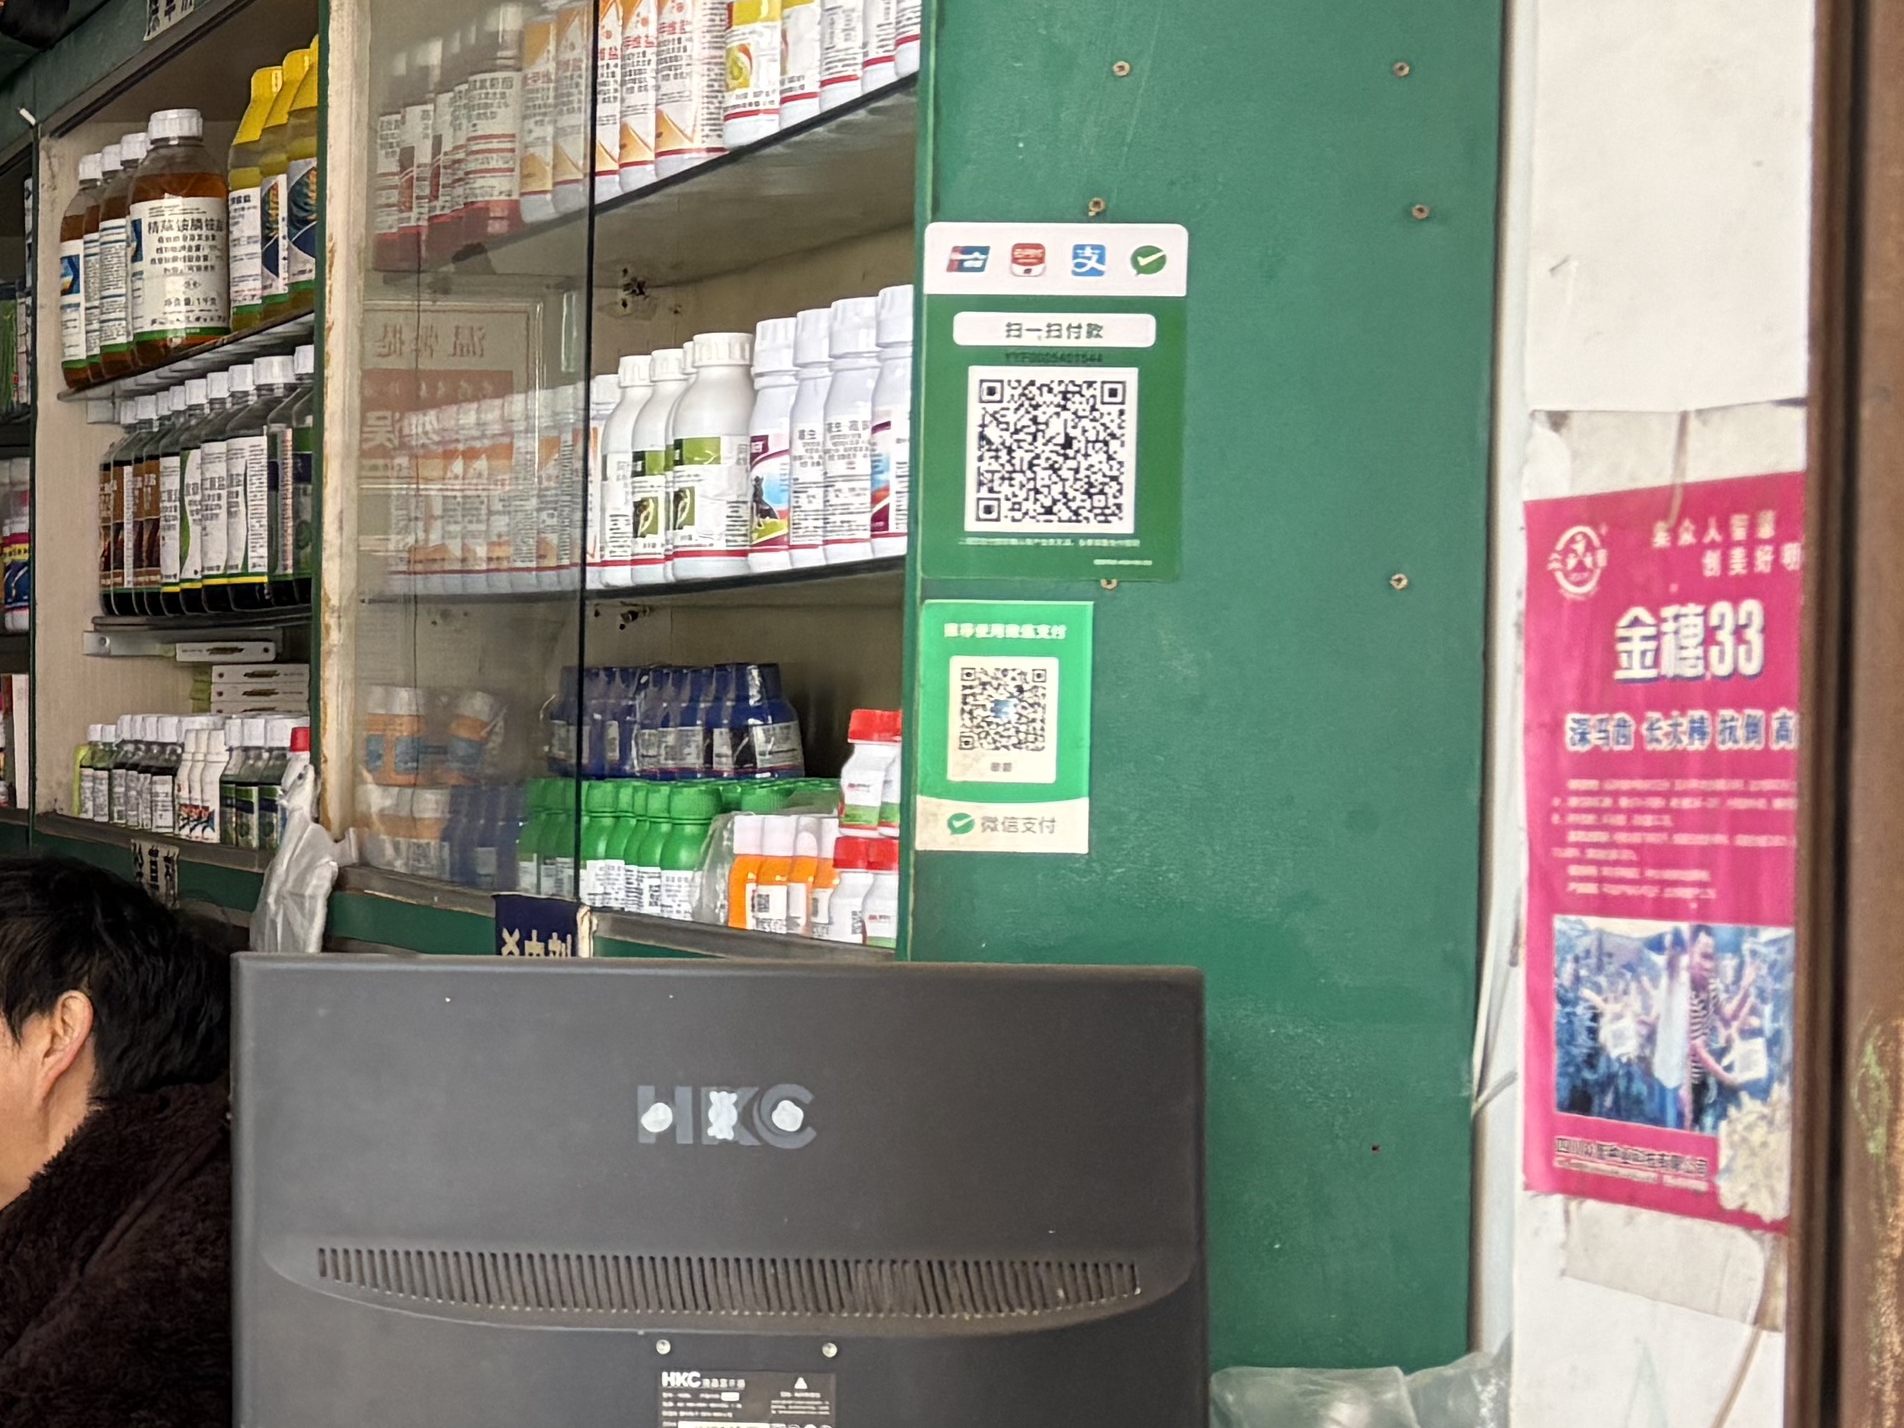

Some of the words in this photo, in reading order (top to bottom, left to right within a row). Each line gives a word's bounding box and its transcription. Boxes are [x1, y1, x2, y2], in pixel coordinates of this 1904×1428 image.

[1005, 321, 1104, 341] 扫一扫付款
[980, 815, 1056, 836] 微信支付
[637, 1083, 817, 1148] HKC
[661, 1370, 701, 1388] HKC
